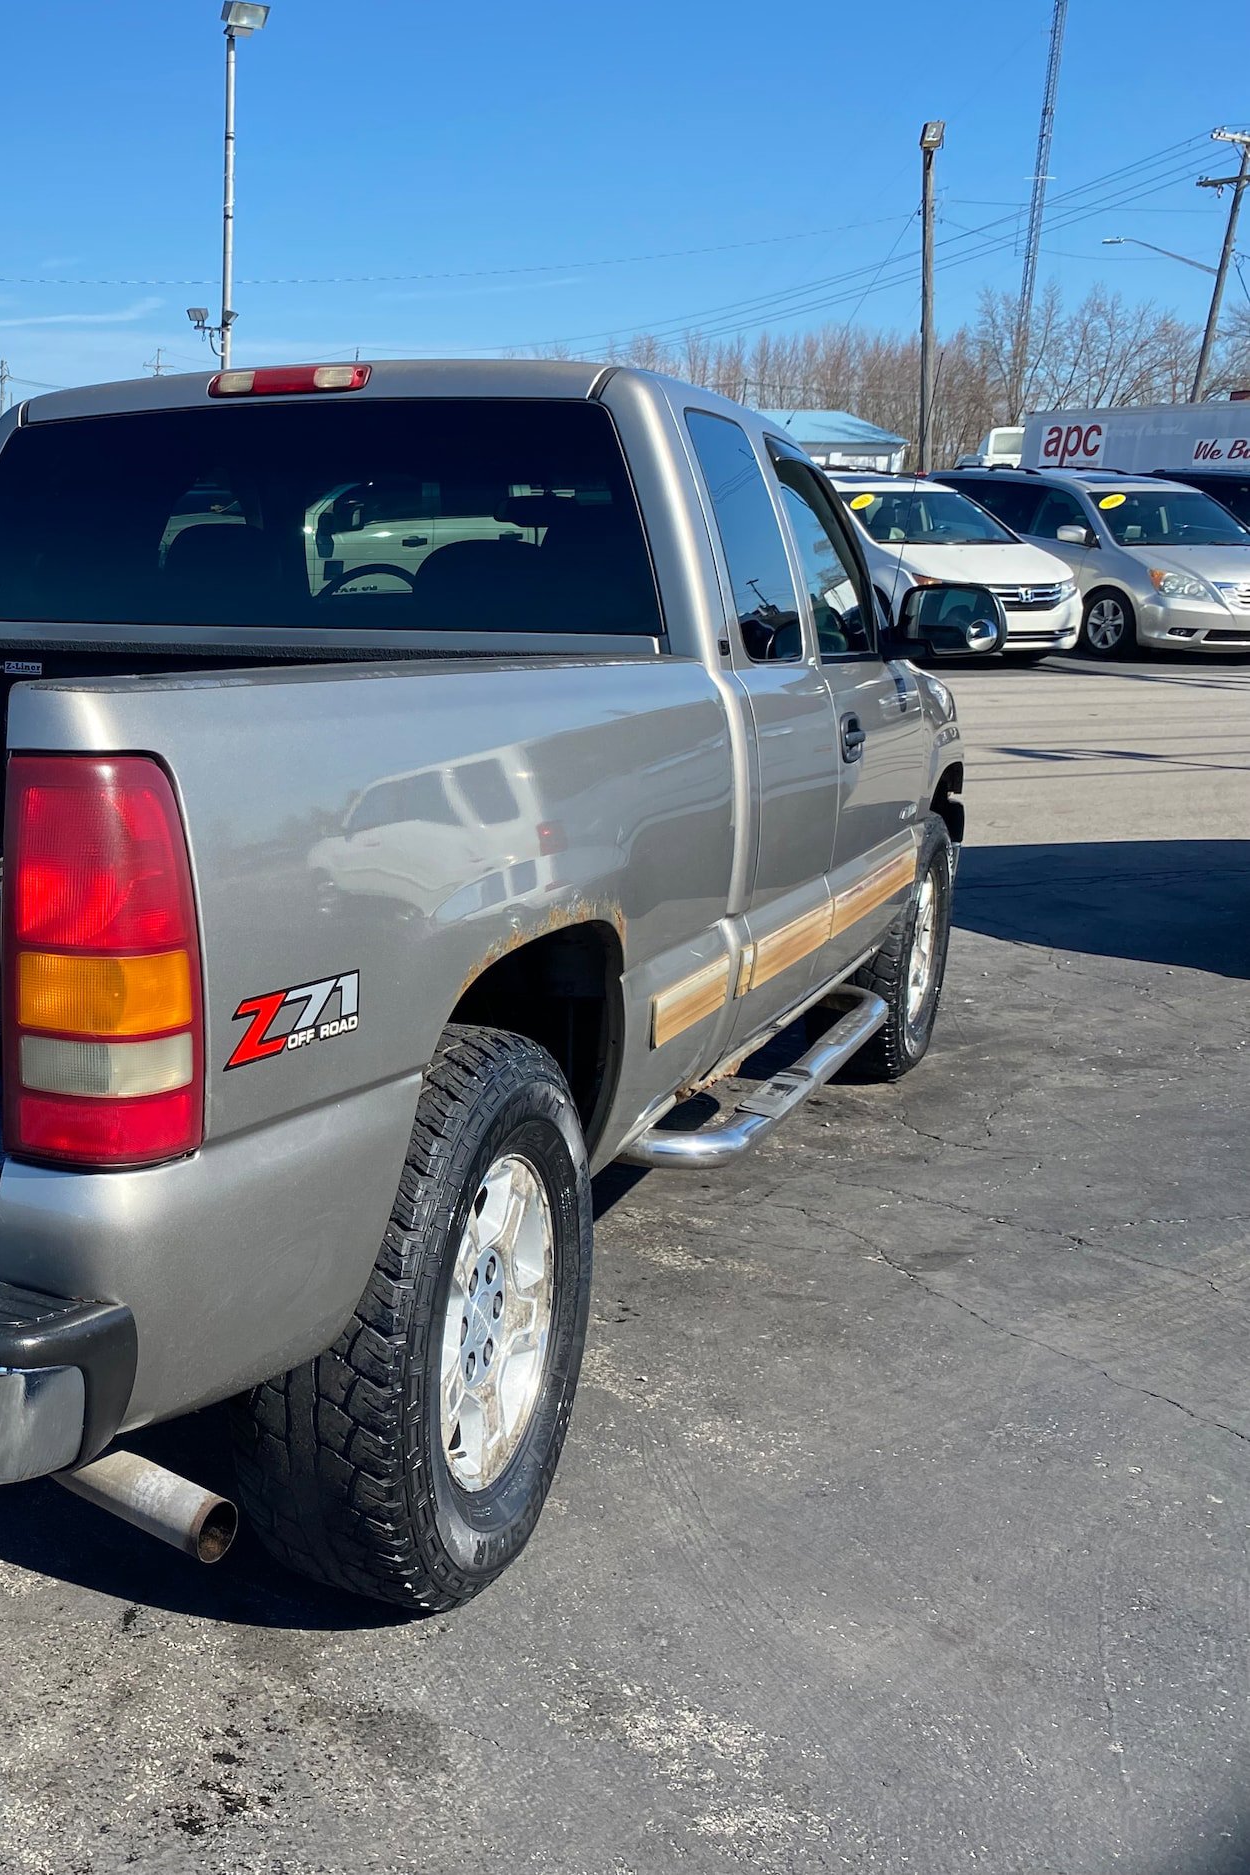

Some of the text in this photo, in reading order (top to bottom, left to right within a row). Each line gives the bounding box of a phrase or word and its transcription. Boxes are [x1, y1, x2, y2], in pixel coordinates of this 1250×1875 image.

[1043, 424, 1102, 467] apc
[1193, 438, 1223, 460] We
[222, 969, 360, 1072] Z71
[287, 1015, 359, 1051] OFF ROAD
